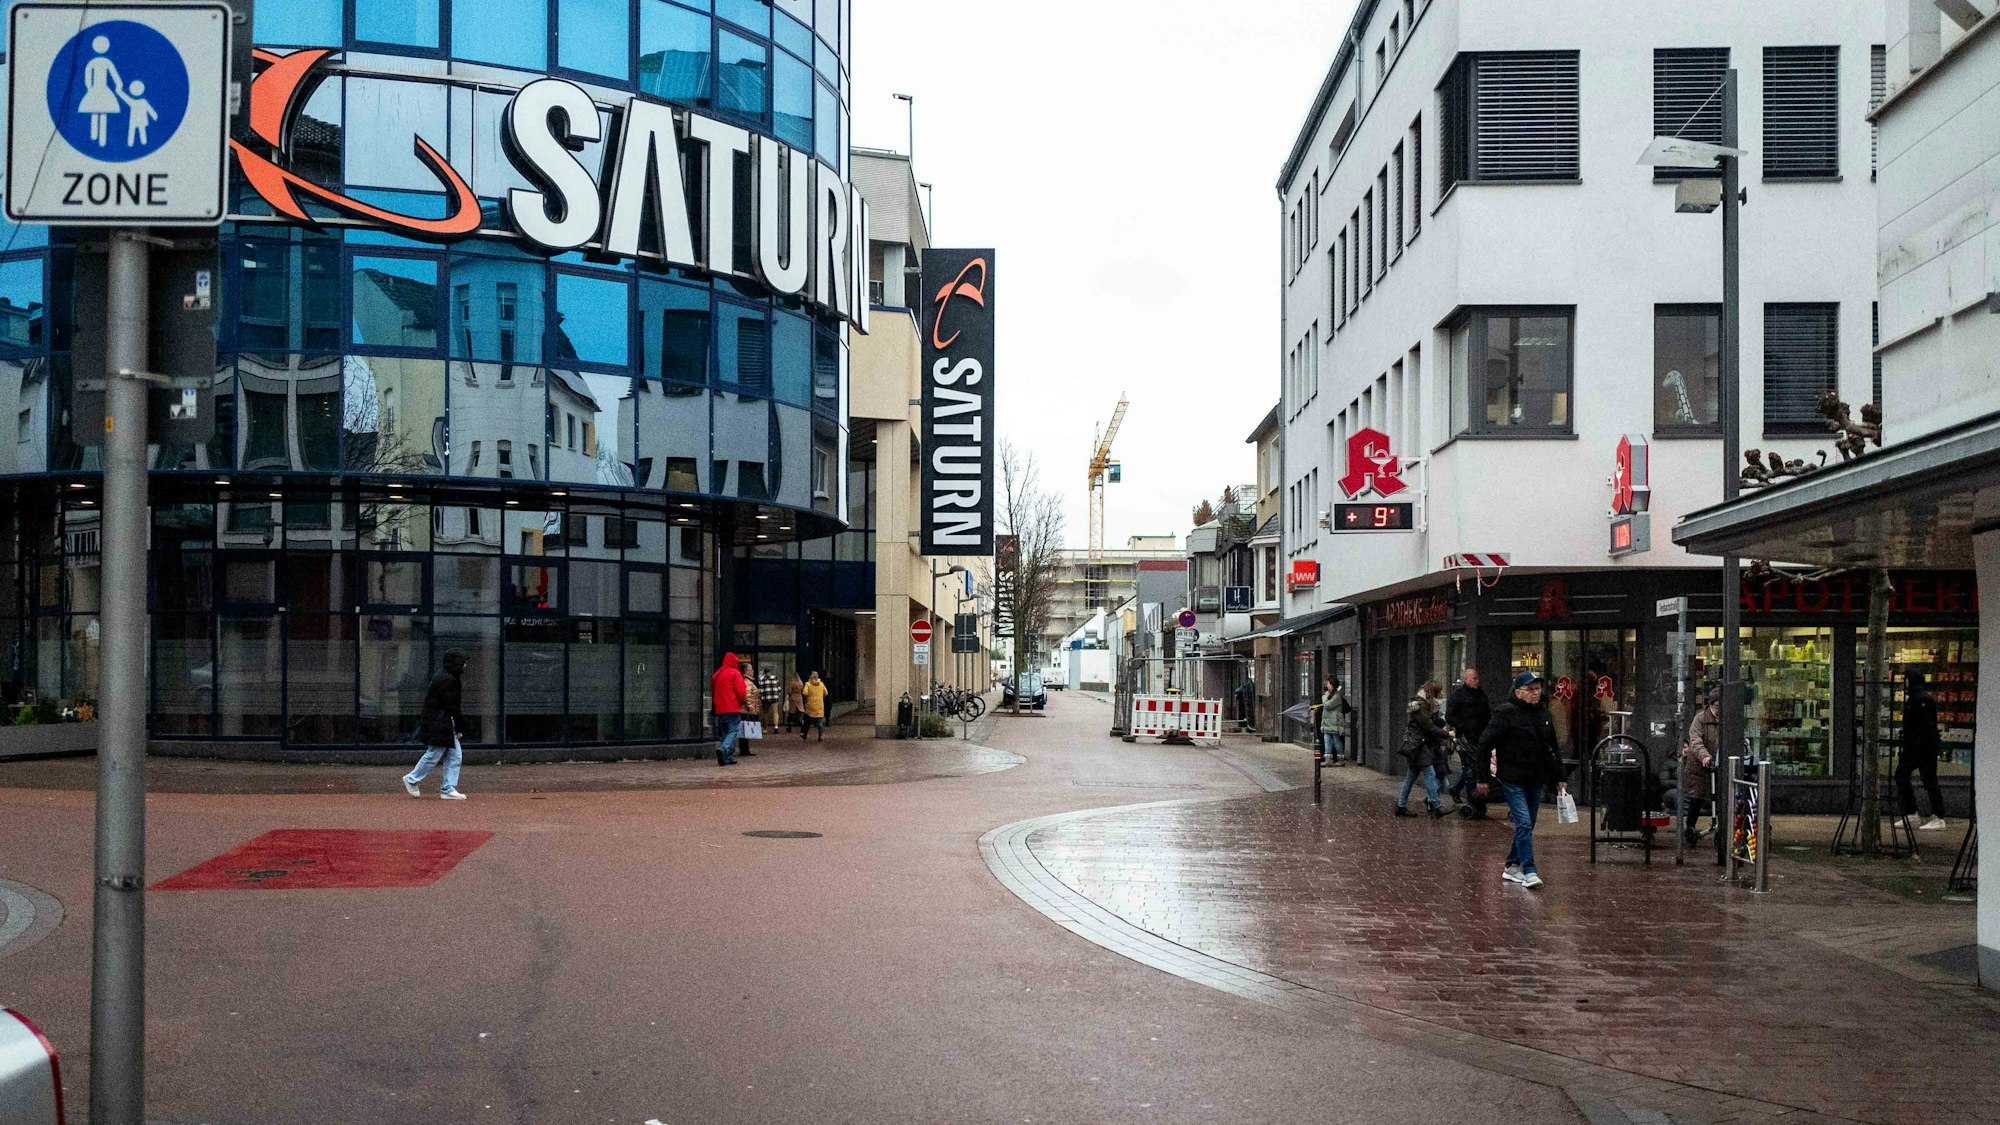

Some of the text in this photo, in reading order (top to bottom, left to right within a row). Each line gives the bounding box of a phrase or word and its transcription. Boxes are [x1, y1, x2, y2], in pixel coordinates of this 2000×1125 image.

[63, 172, 169, 207] ZONE
[503, 77, 870, 335] SATURN
[932, 356, 983, 547] SATURN
[998, 570, 1015, 636] SATURN
